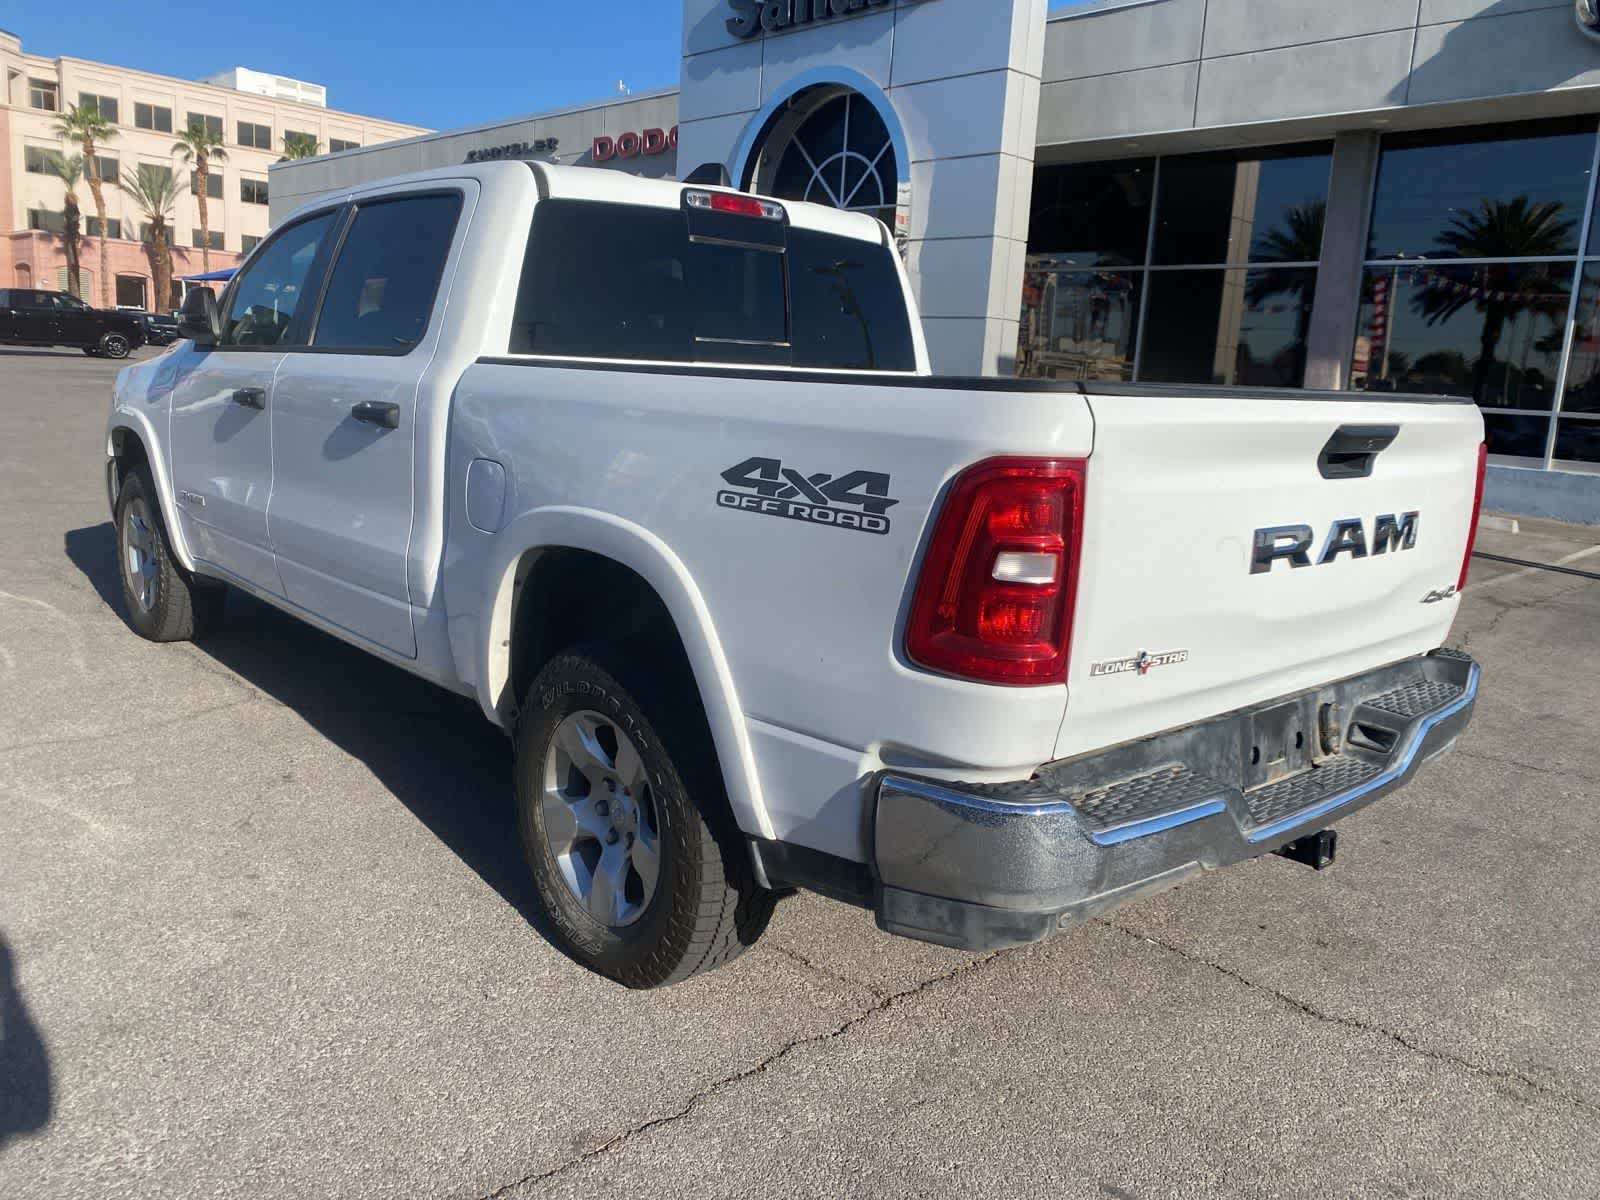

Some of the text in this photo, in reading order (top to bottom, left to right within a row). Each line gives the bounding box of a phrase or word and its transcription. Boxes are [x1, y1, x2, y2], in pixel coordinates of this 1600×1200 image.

[718, 492, 887, 531] OFF ROAD
[1249, 511, 1419, 575] RAM
[1090, 650, 1188, 676] LONE STAR
